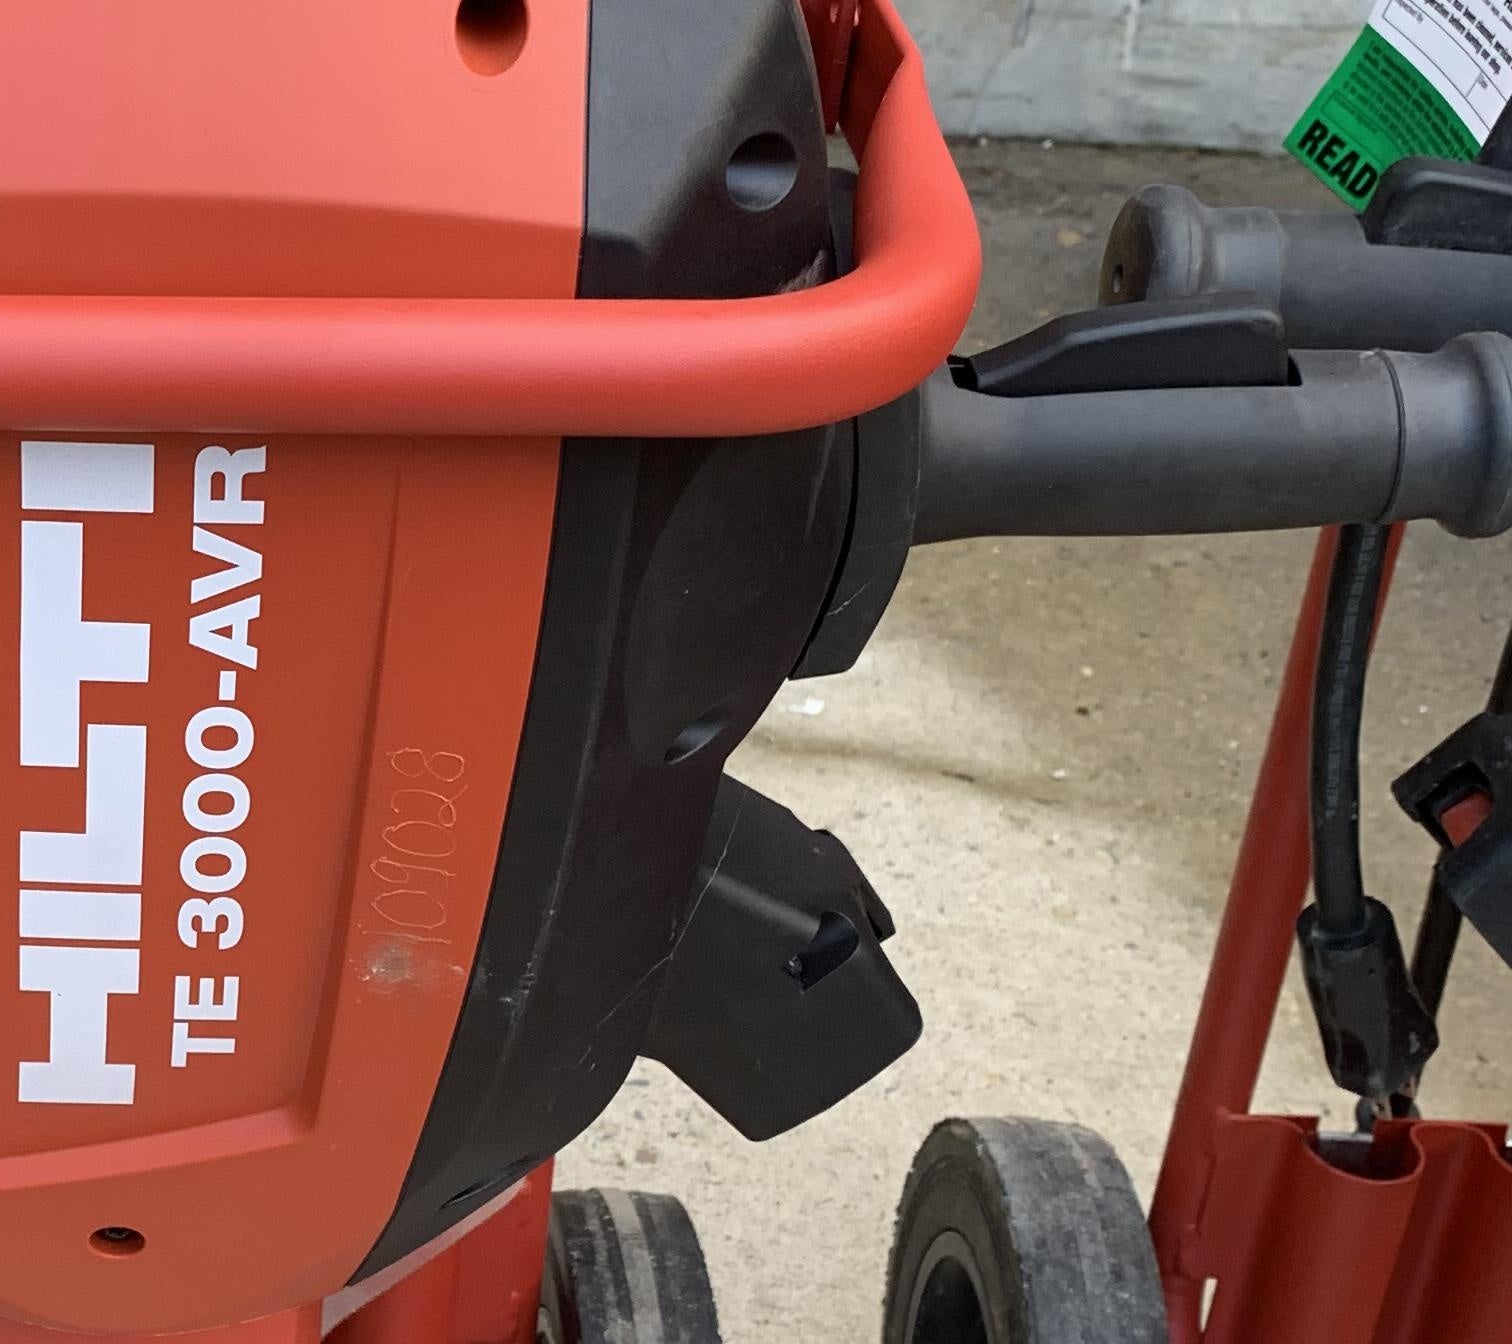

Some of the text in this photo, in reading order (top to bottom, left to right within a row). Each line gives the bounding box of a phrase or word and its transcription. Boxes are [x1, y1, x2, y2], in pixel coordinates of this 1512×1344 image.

[1297, 119, 1378, 199] READ
[18, 441, 155, 1105] HILTI
[170, 445, 267, 1069] TE 3000-AVR
[360, 746, 469, 945] 109028
